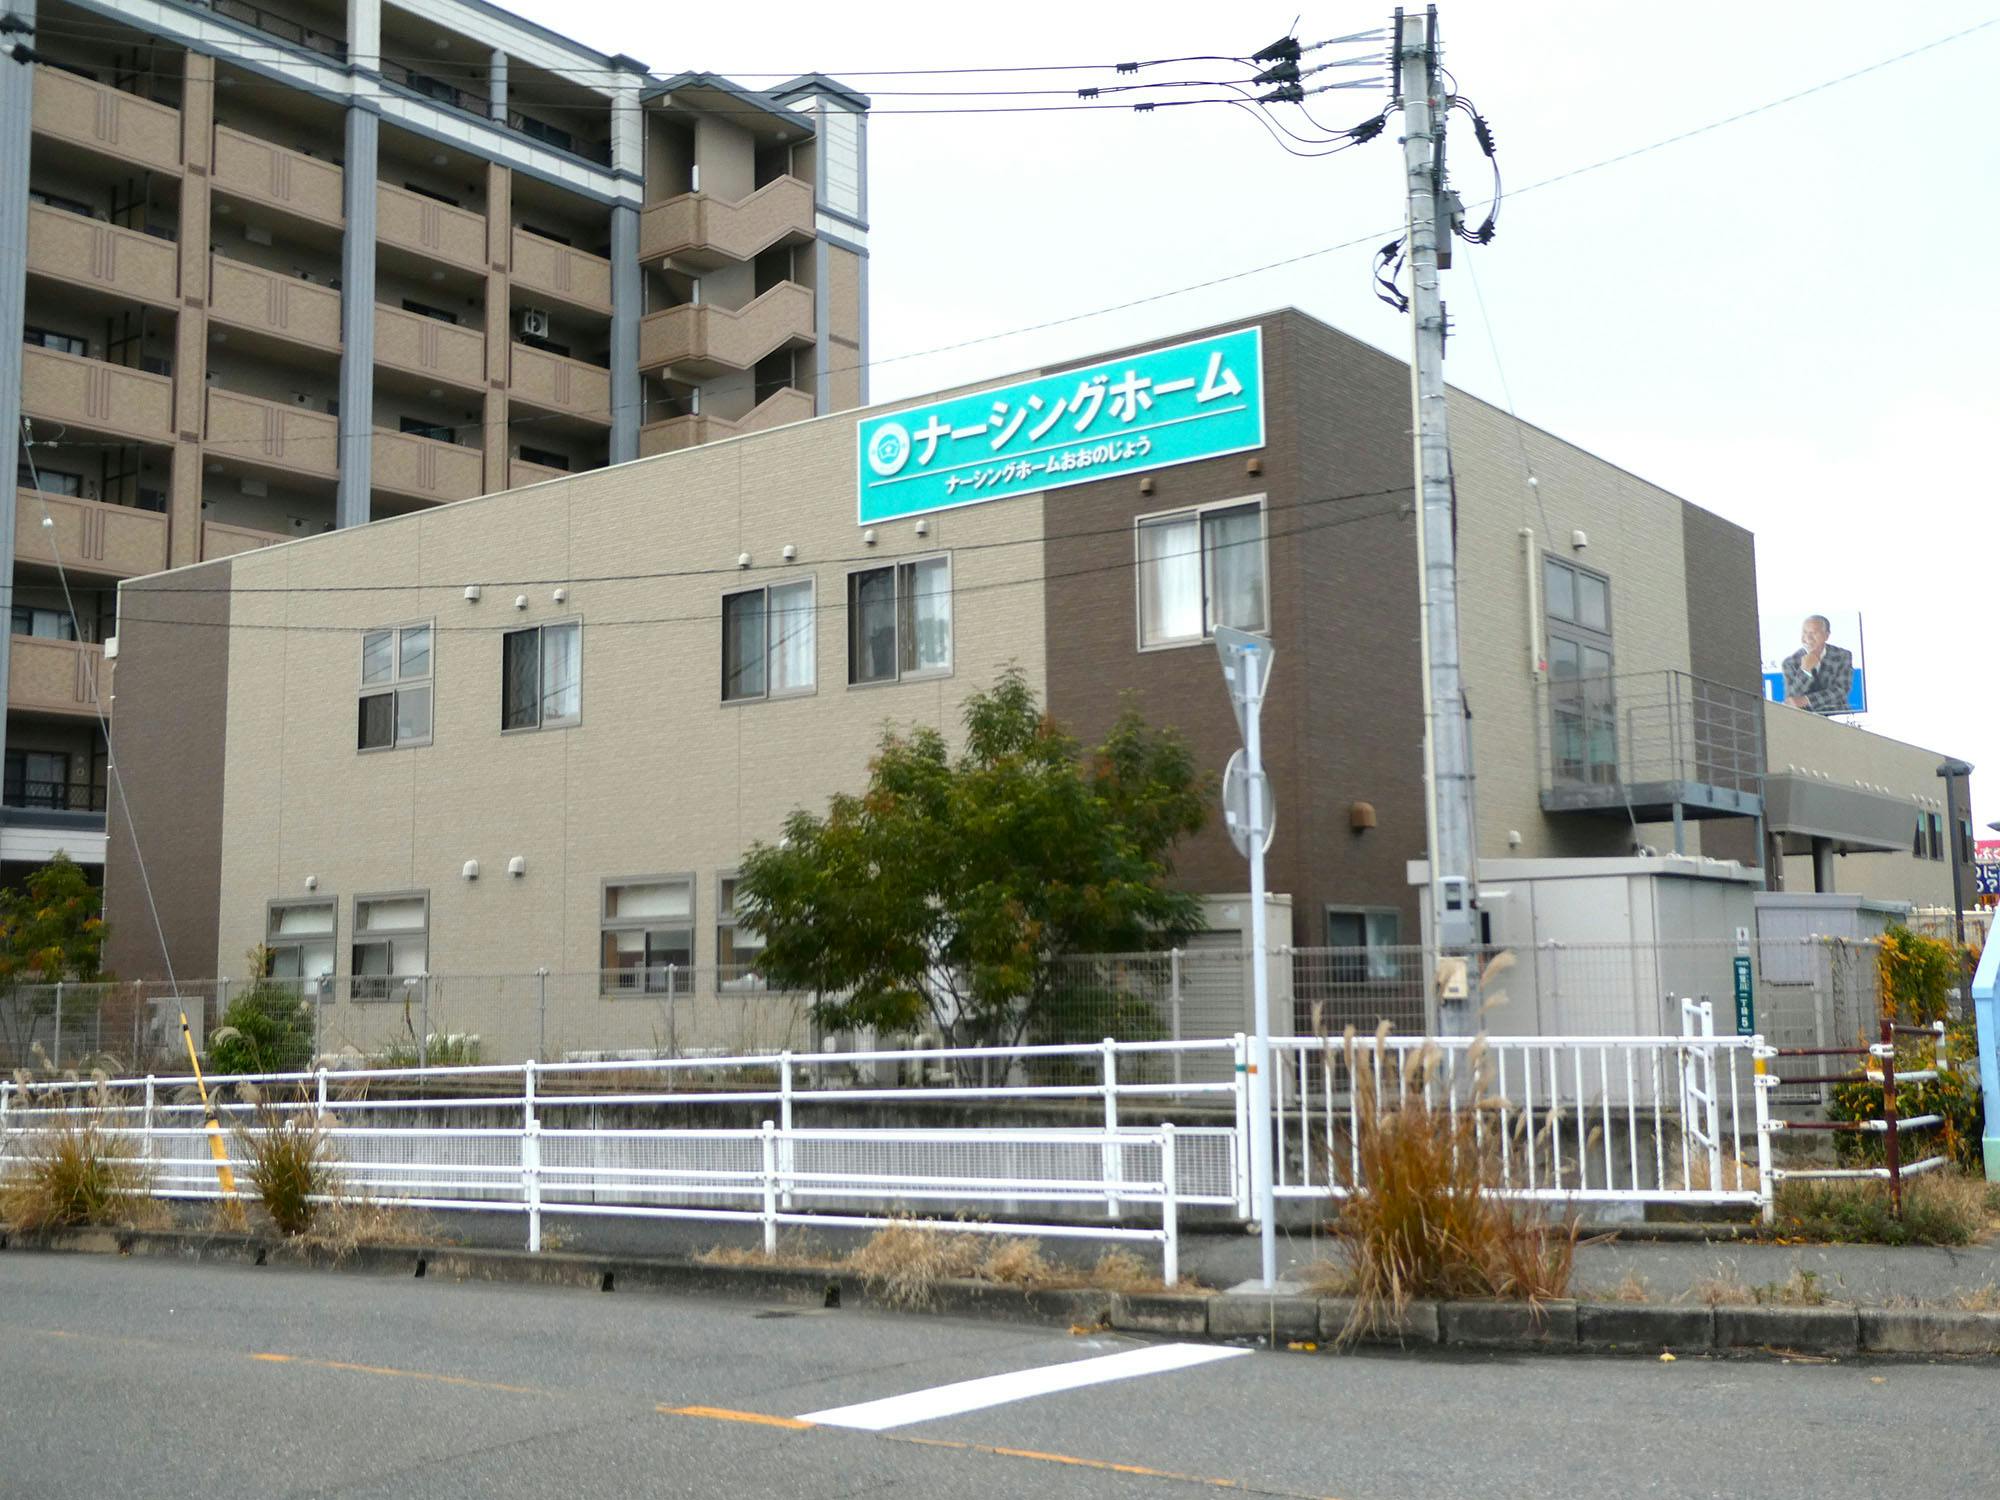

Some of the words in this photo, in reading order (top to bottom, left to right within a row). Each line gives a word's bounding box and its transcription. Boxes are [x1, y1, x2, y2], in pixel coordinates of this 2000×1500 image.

[914, 352, 1243, 465] ナーシングホーム
[946, 436, 1152, 495] ナーシングホームおおのじょう
